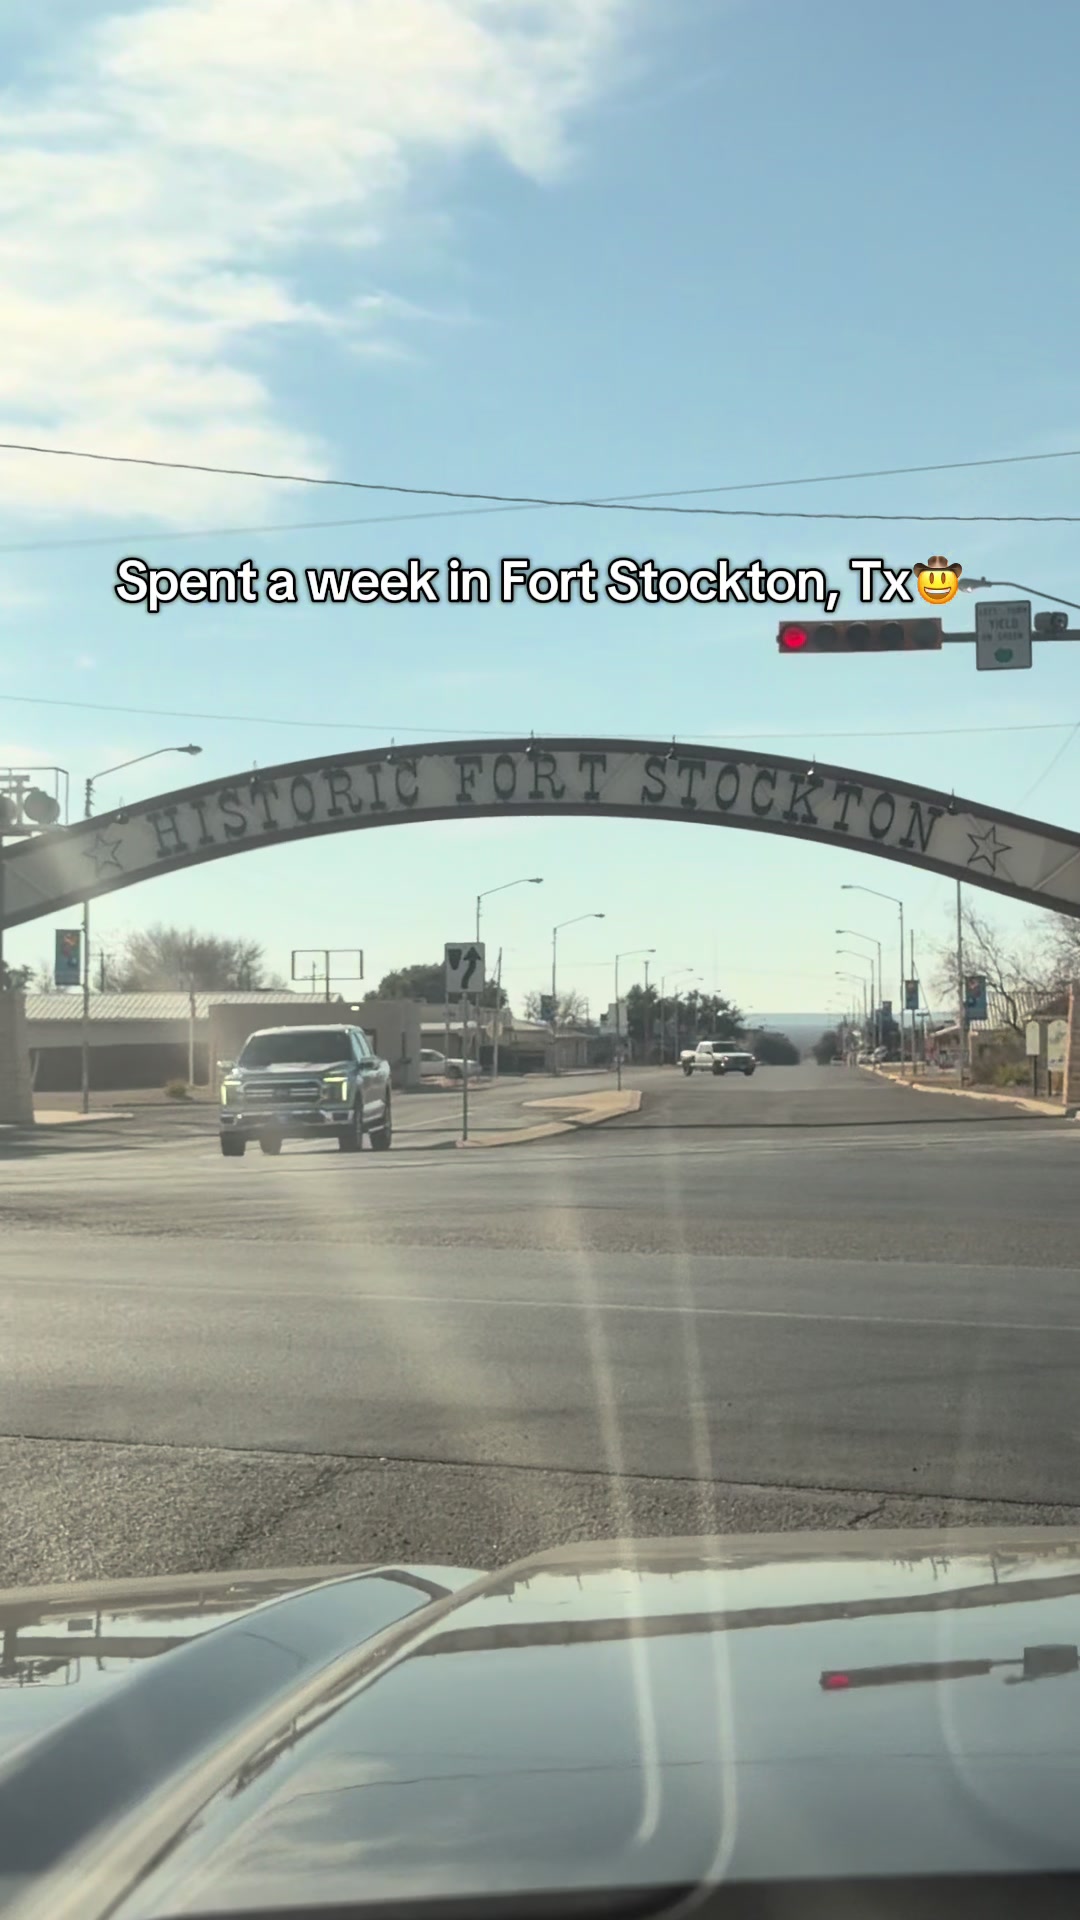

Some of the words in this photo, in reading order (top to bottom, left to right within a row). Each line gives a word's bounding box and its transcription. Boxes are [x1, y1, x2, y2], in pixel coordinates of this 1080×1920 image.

[989, 618, 1019, 630] YIELD
[146, 763, 420, 858] HISTORIC
[455, 754, 607, 802] FORT
[641, 756, 947, 853] STOCKTON
